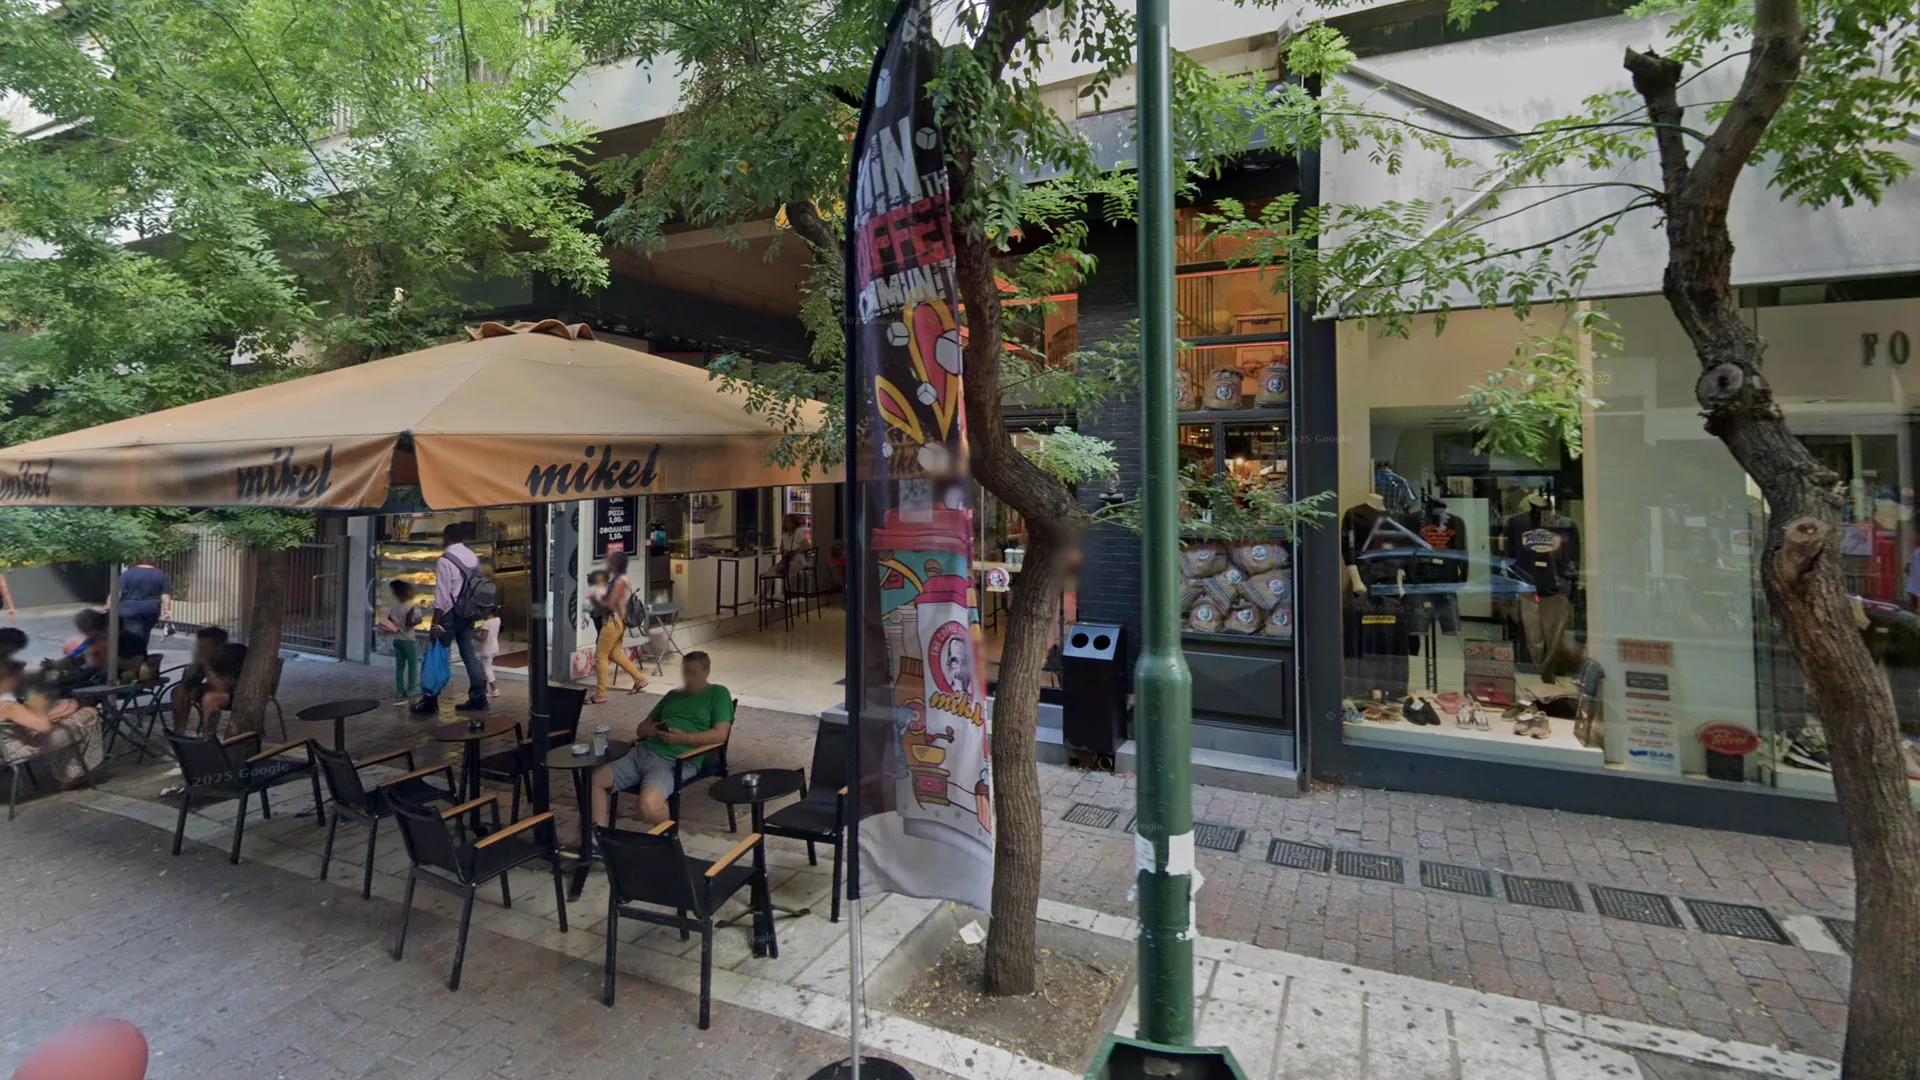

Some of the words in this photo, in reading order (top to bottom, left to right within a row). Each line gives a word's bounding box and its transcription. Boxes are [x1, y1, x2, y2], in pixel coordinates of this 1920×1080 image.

[920, 167, 949, 198] TH
[857, 193, 957, 290] OFFE
[237, 444, 333, 498] mikel
[525, 443, 660, 497] mikel
[929, 690, 984, 726] mikl
